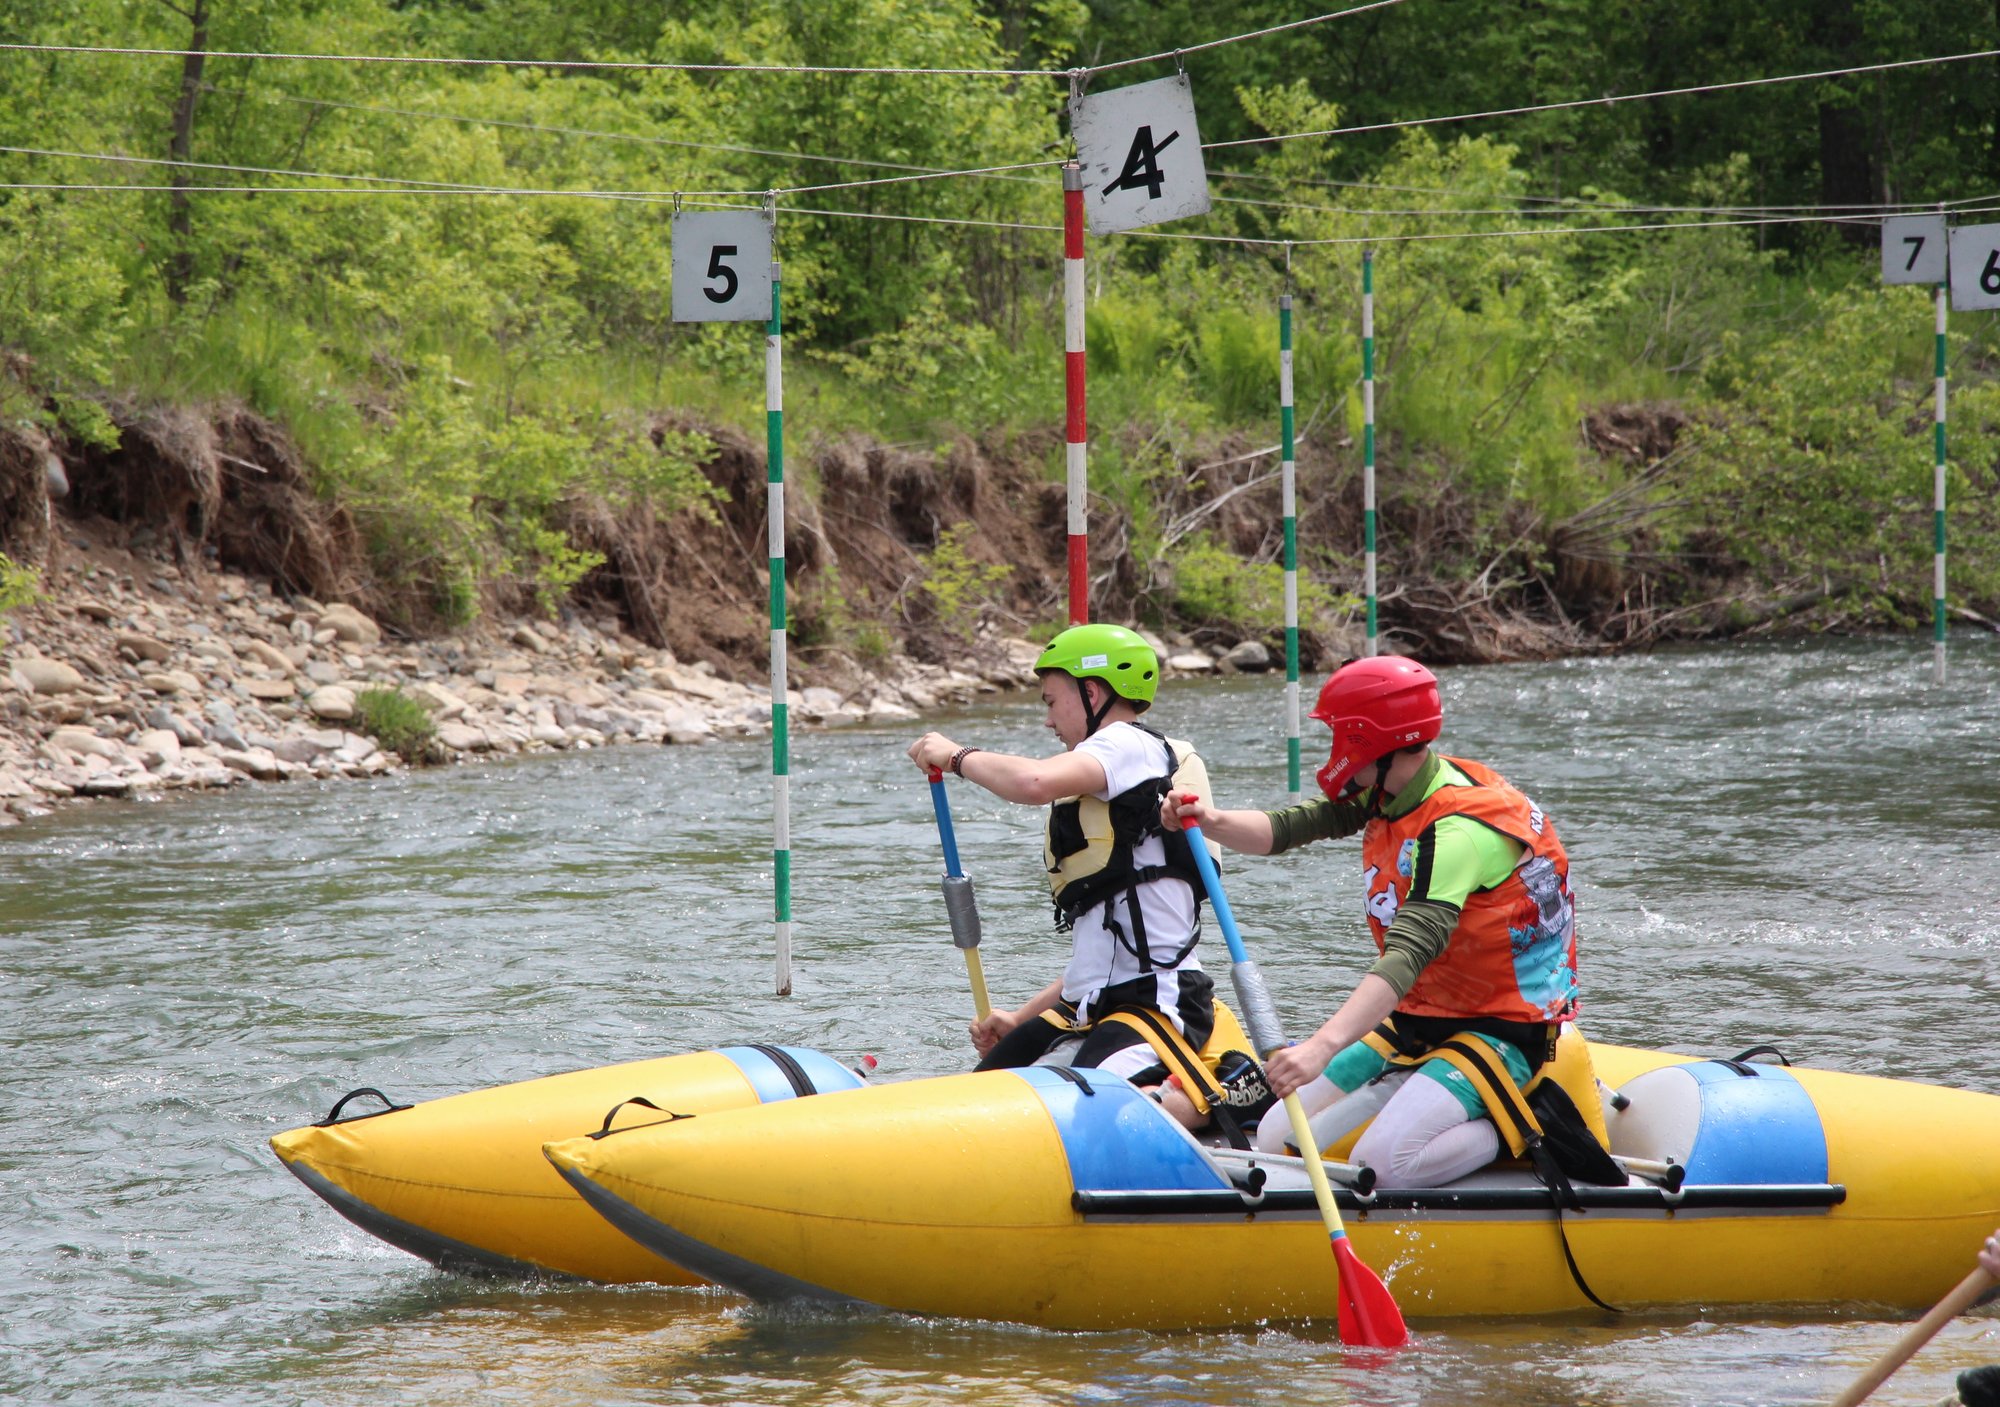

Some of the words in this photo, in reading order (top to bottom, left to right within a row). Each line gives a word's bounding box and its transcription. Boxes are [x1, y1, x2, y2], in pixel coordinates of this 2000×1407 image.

[1111, 125, 1172, 199] 4
[702, 245, 739, 304] 5
[1903, 236, 1926, 272] 7
[1979, 248, 2000, 295] 6
